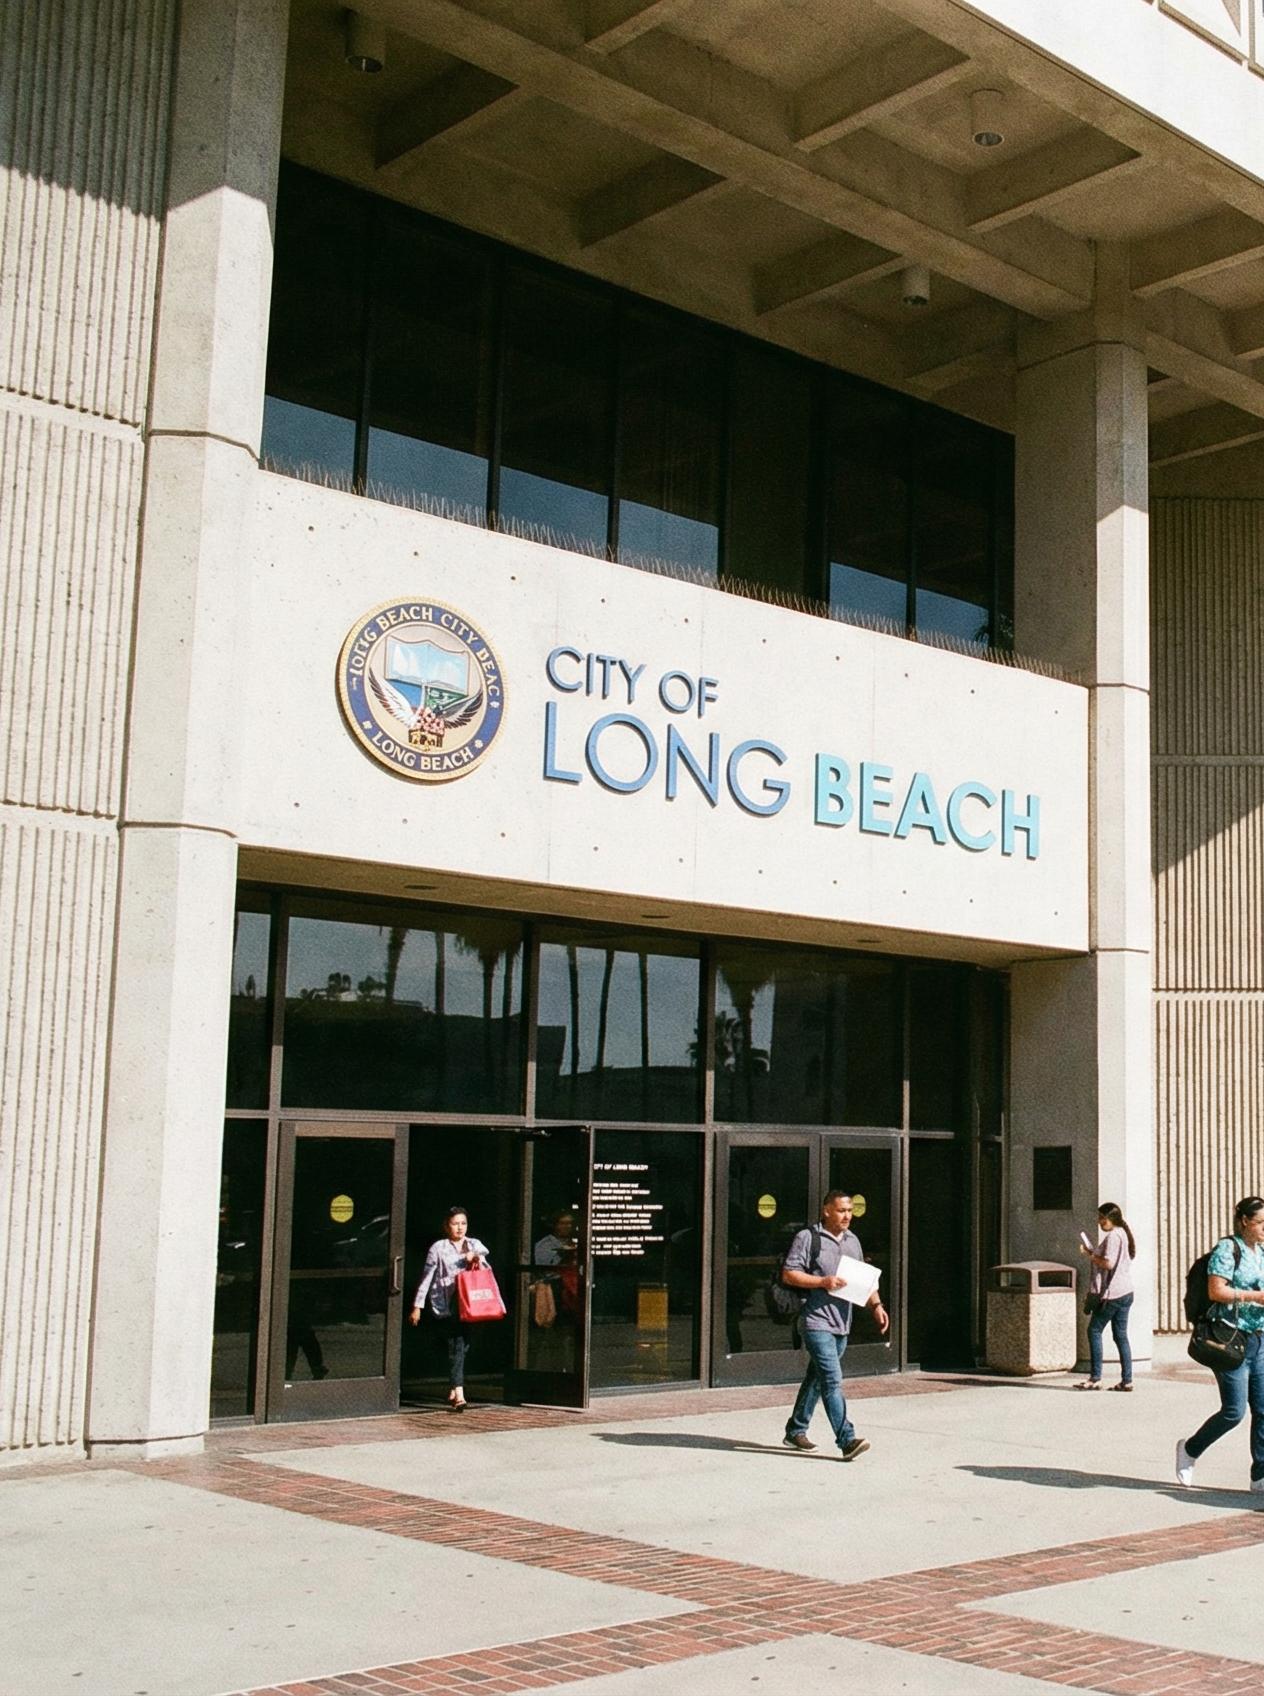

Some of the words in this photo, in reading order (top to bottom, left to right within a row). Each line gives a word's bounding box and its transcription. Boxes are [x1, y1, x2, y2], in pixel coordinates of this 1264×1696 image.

[376, 606, 433, 630] BEACH
[440, 613, 479, 644] CITY
[546, 646, 646, 704] CITY
[658, 670, 719, 718] OF
[371, 732, 417, 767] LONG
[420, 747, 475, 771] BEACH
[543, 700, 791, 817] LONG
[814, 752, 1040, 860] BEACH
